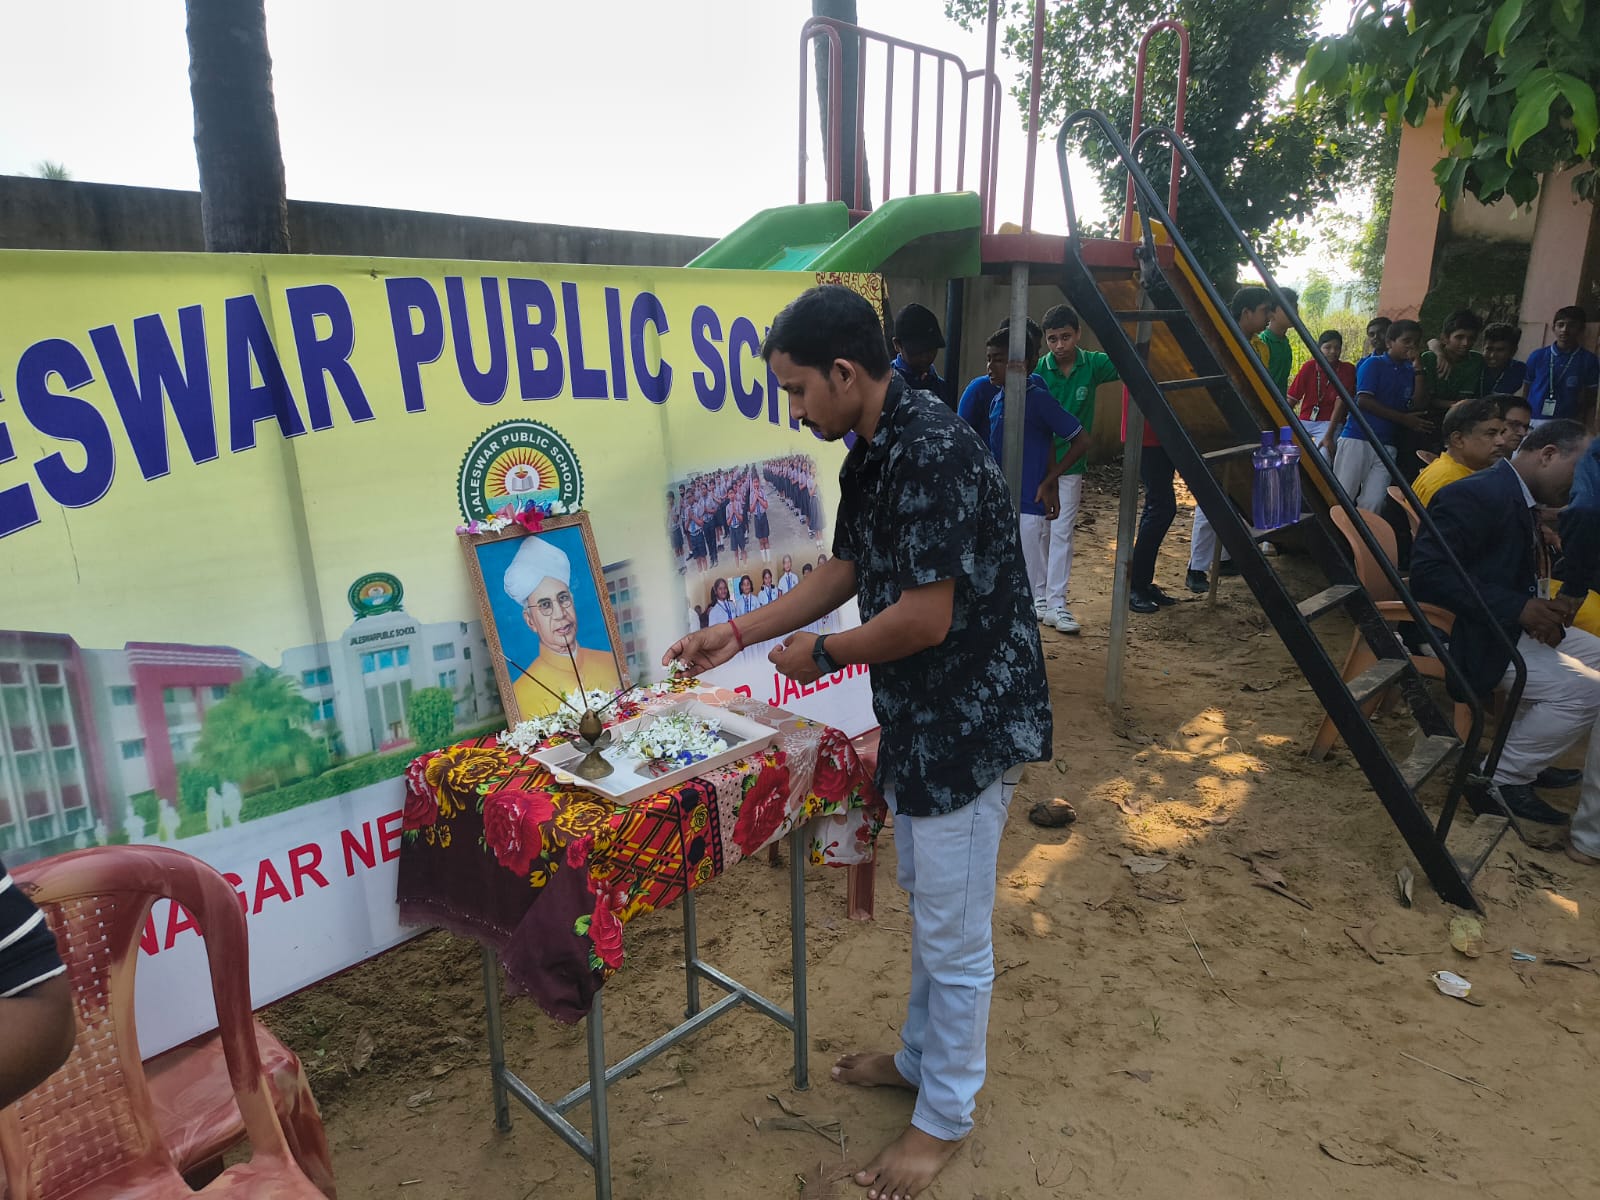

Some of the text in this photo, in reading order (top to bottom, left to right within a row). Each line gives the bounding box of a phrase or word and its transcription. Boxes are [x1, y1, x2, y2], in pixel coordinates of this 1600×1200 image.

[385, 276, 674, 414] PUBLIC
[470, 432, 573, 514] JALESWAR PUBLIC SCHOOL
